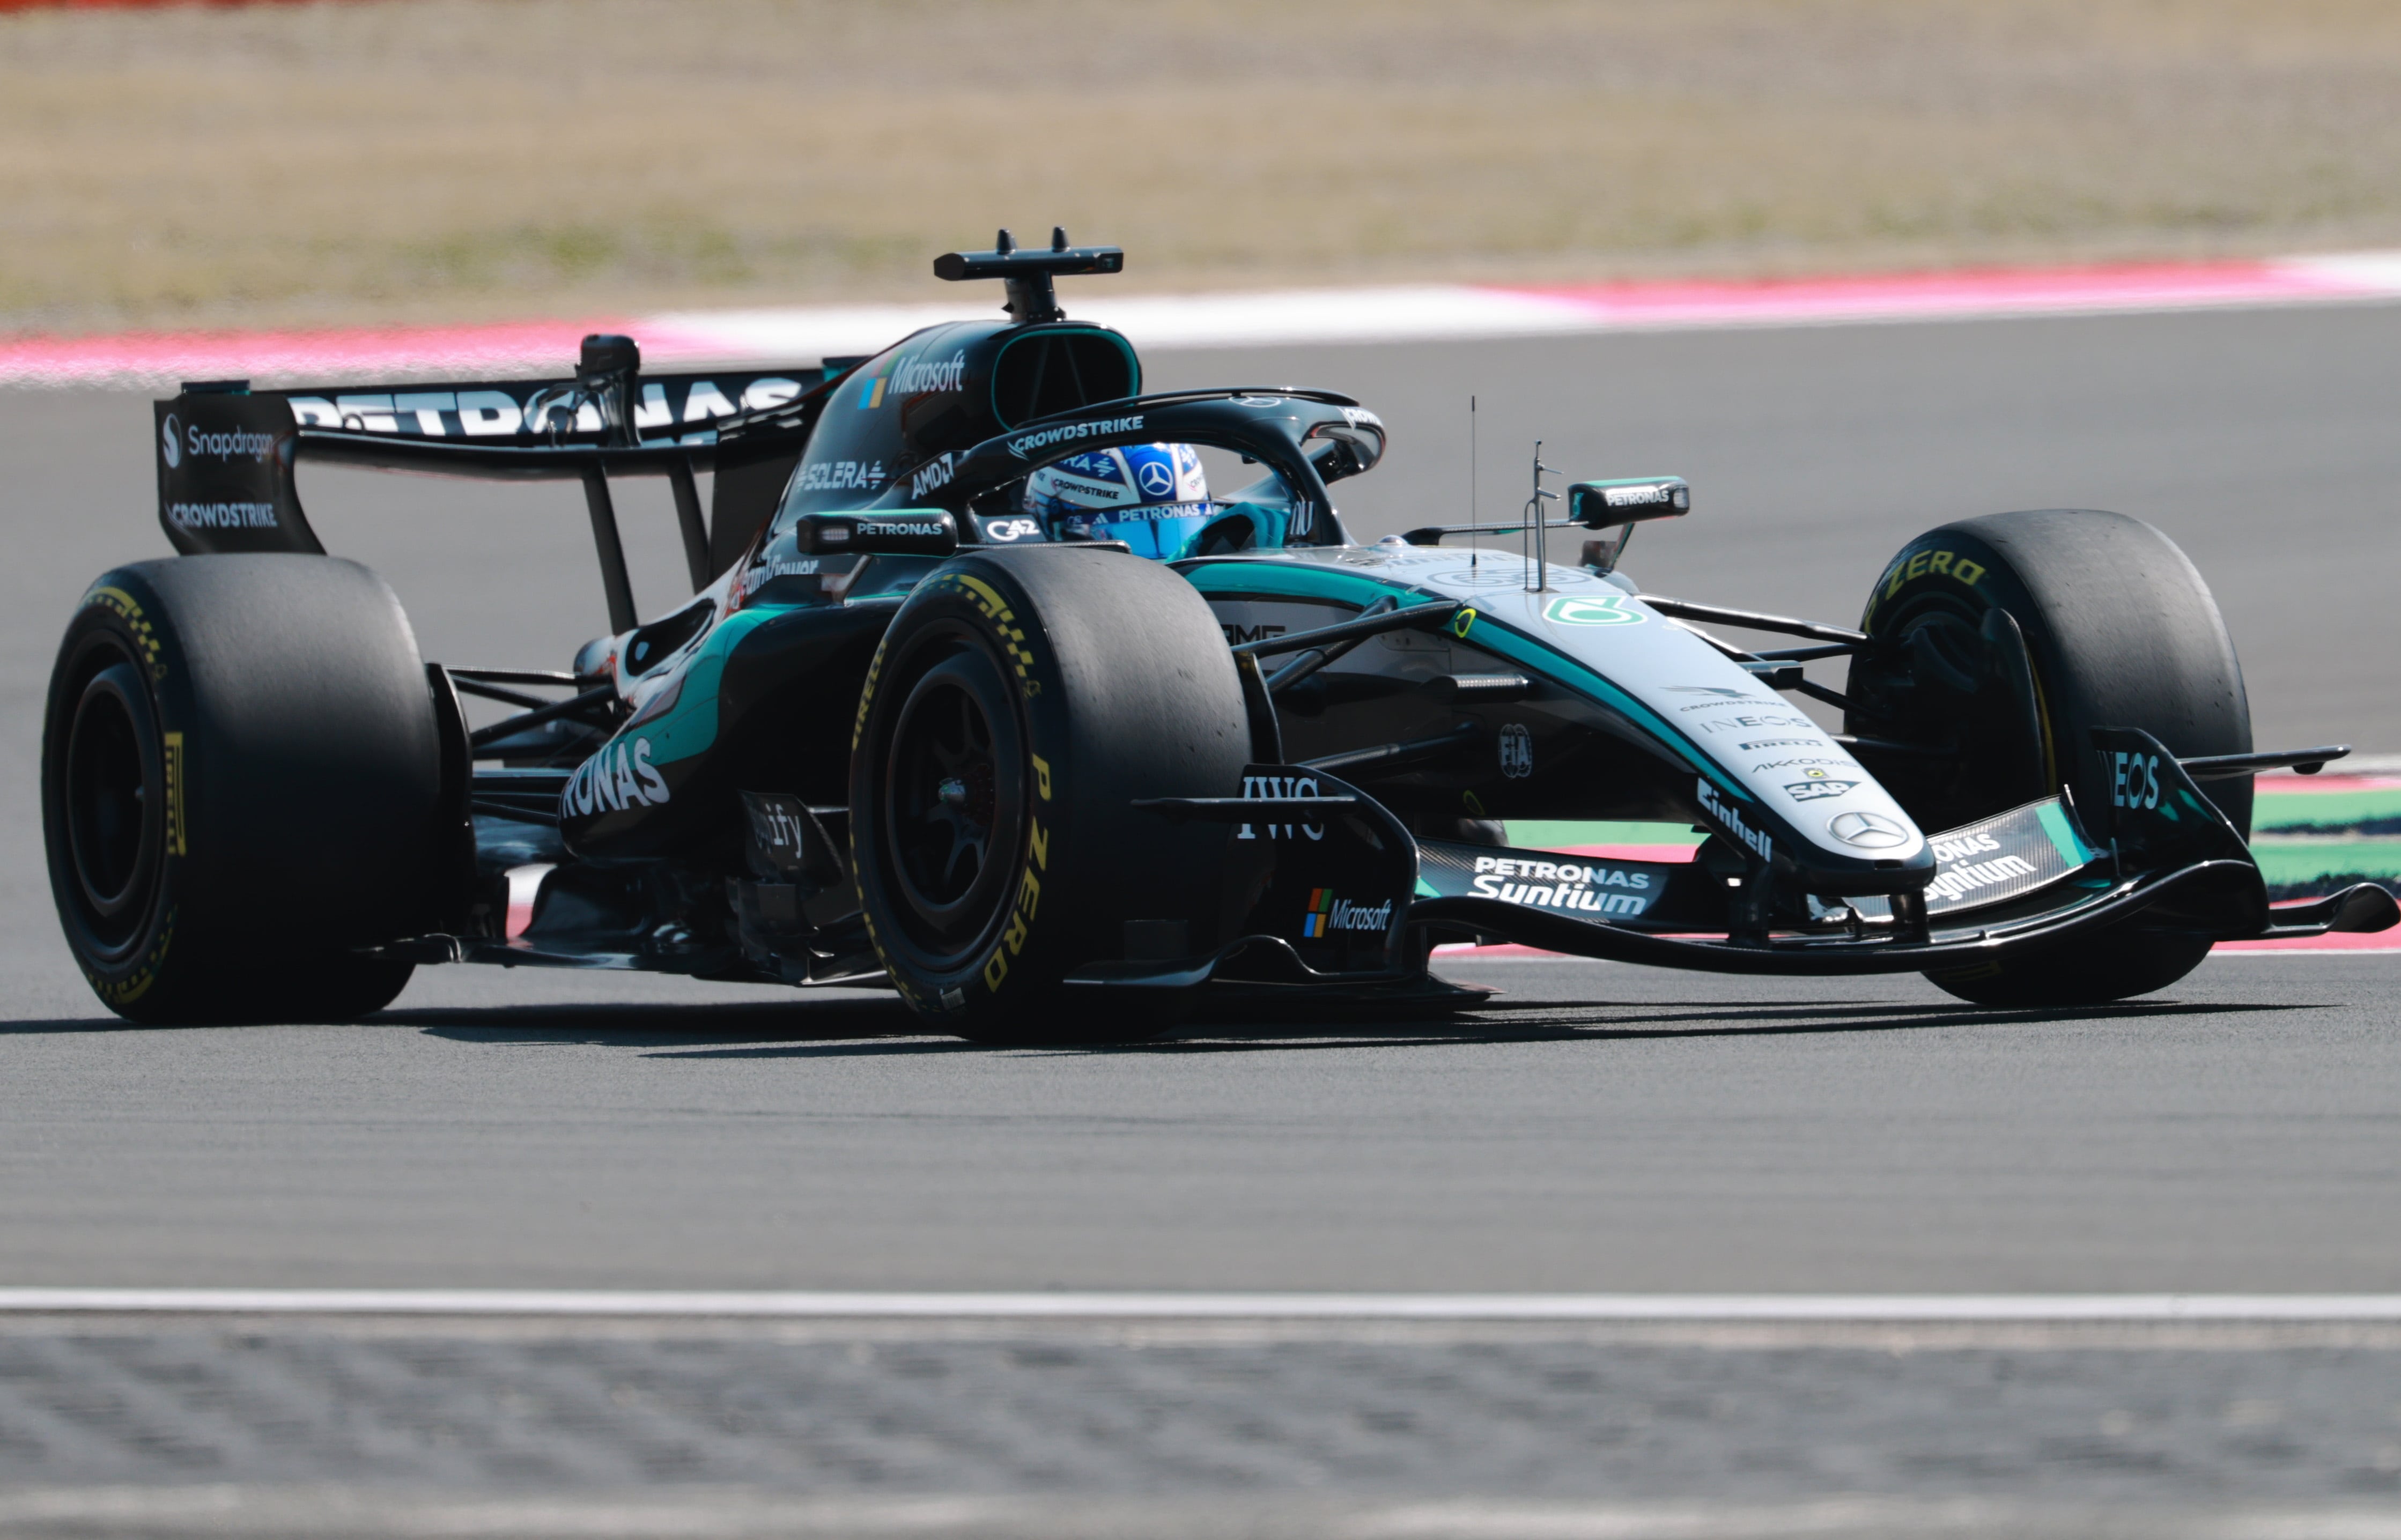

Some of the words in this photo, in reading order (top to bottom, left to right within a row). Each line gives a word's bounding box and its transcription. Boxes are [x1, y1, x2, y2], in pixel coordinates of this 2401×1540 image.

[889, 349, 964, 395] Microsoft
[188, 425, 273, 463] Snapdragon
[1015, 416, 1144, 452] CROWDSTRIKE
[804, 461, 867, 490] SOLERA
[912, 463, 942, 500] AMD
[1054, 478, 1119, 500] CROWDSTRIKE
[1119, 504, 1200, 522] PETRONAS
[1607, 490, 1669, 506] PETRONAS
[173, 502, 277, 528] CROWDSTRIKE
[857, 523, 942, 535] PETRONAS
[1885, 549, 1986, 601] ZERO
[1680, 700, 1789, 712] CROWDSTRIKE
[1700, 715, 1812, 733] INEOS
[1739, 738, 1823, 750] PIRELLI
[562, 737, 670, 819] RONAS
[1032, 753, 1051, 801] P
[1788, 782, 1850, 799] SAP
[1697, 776, 1772, 862] Einhell
[1475, 856, 1649, 889] PETRONAS
[984, 815, 1048, 993] ZERO
[1329, 898, 1391, 930] Microsoft
